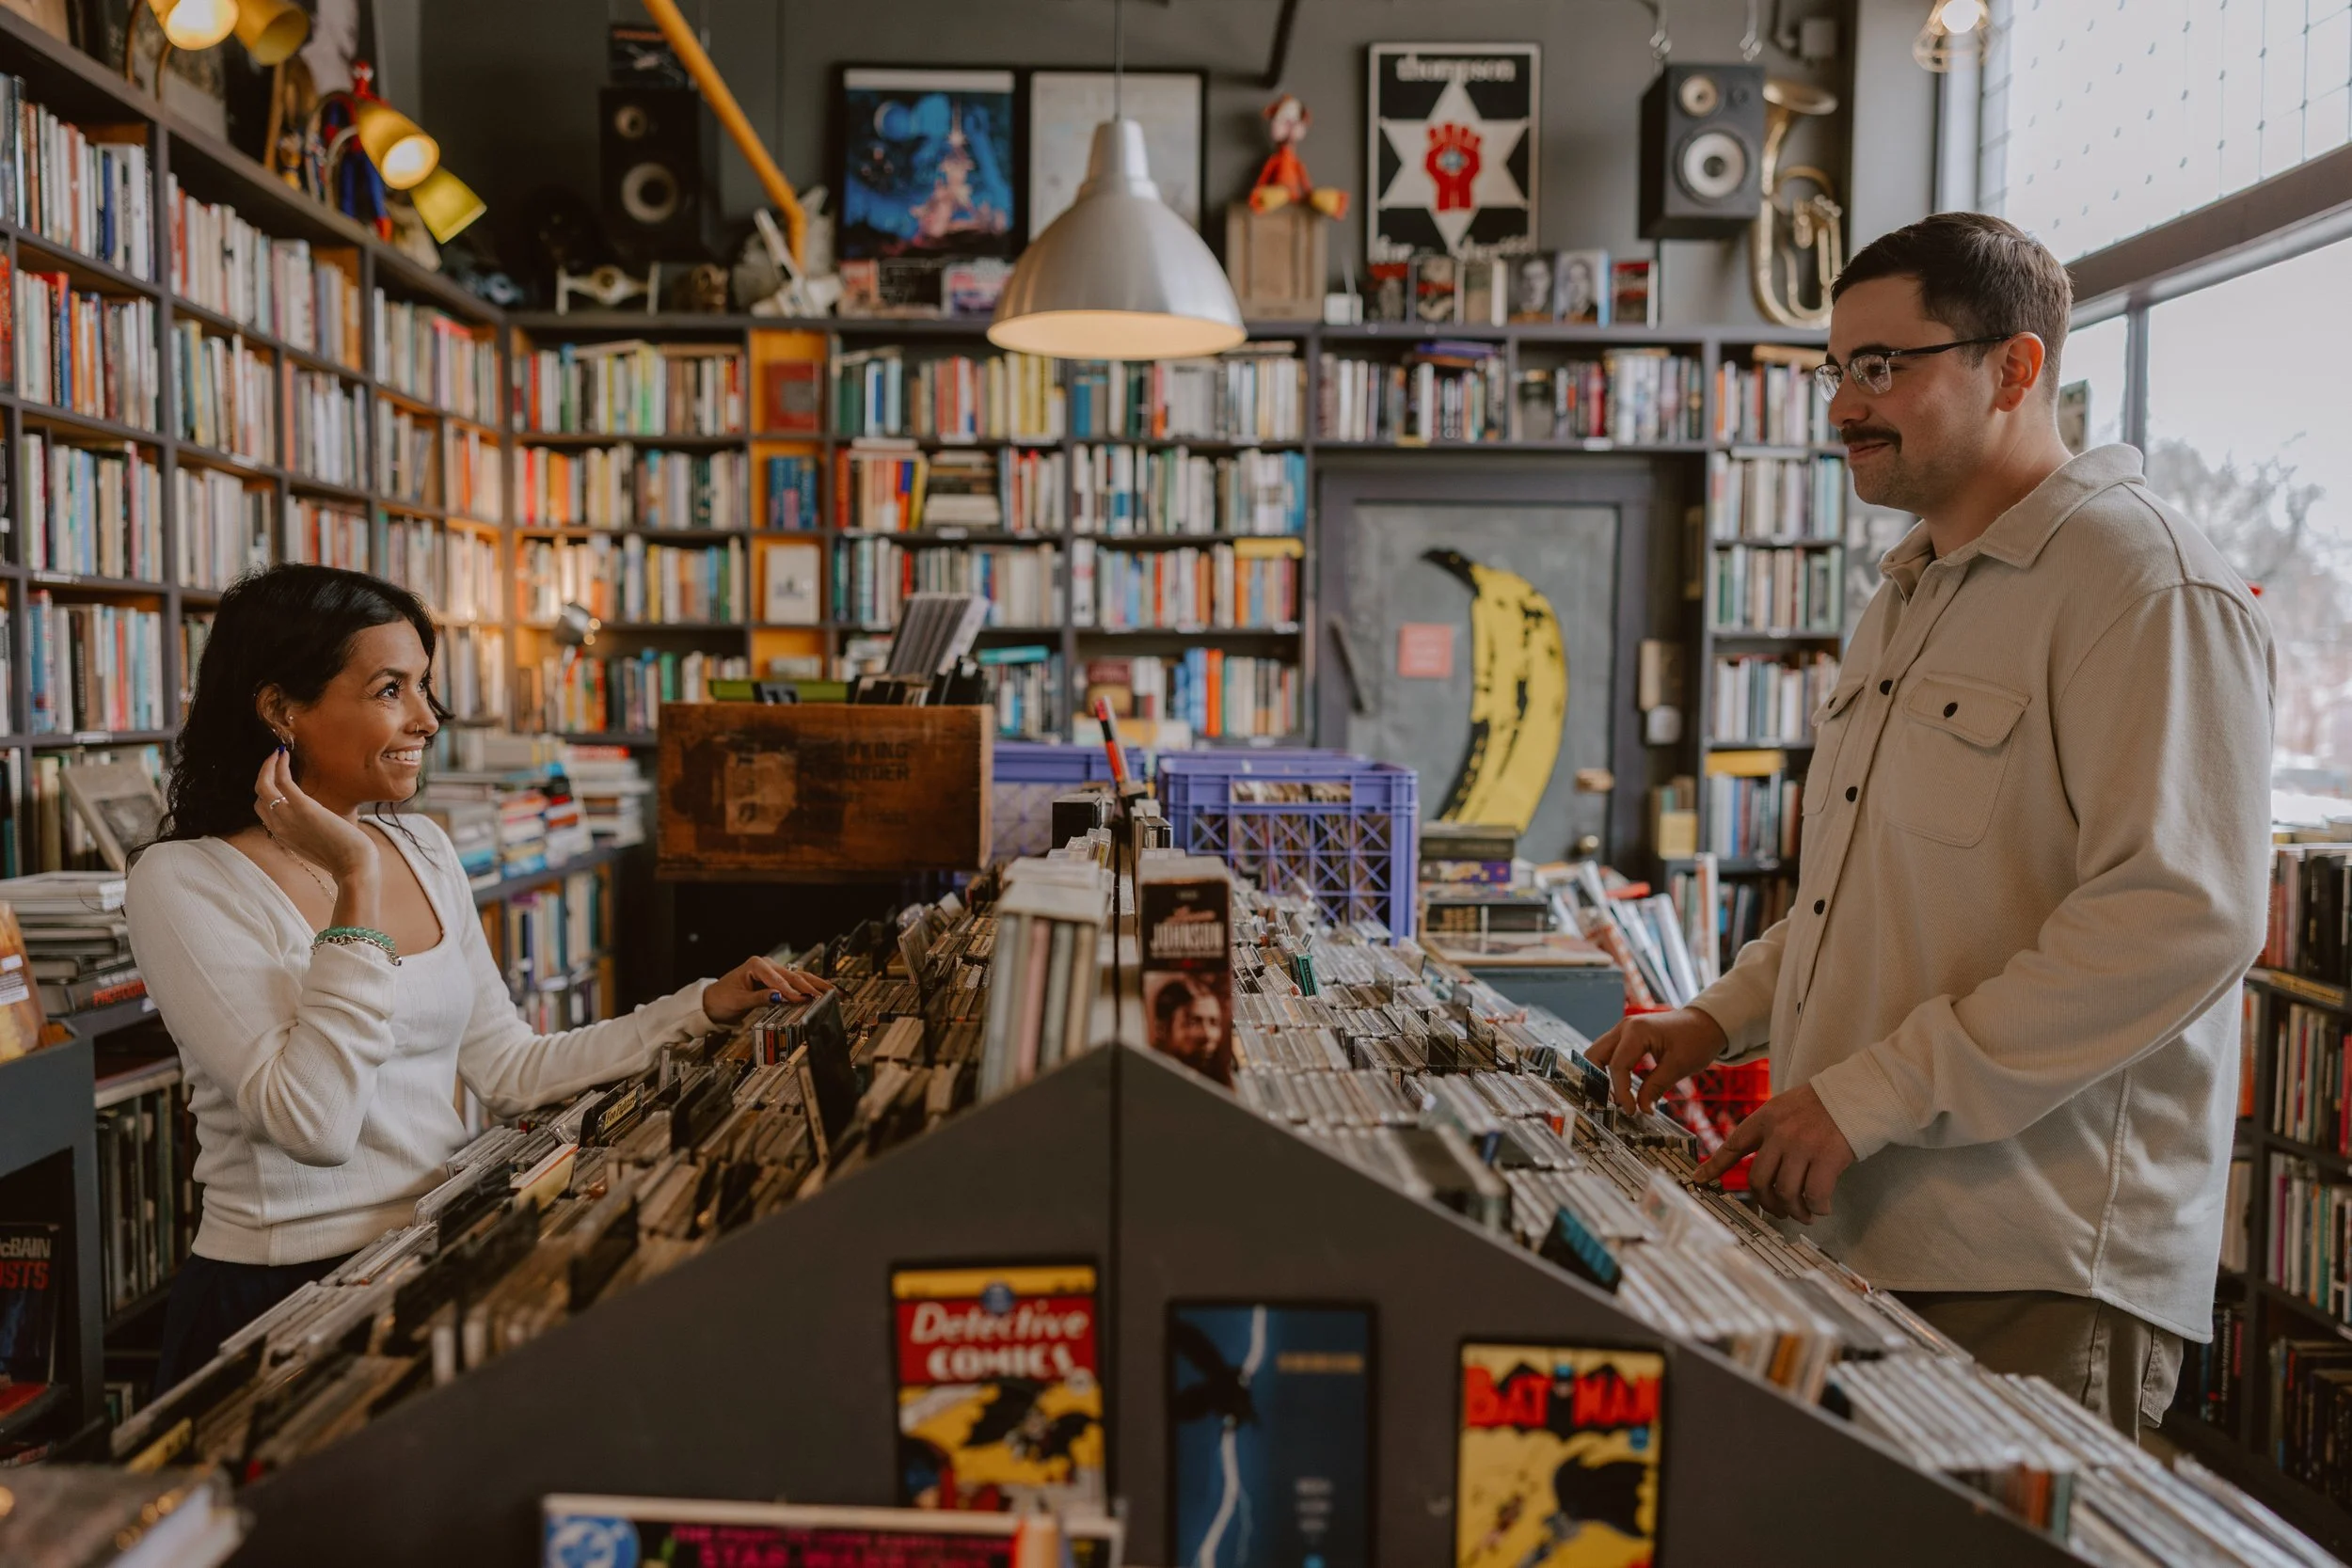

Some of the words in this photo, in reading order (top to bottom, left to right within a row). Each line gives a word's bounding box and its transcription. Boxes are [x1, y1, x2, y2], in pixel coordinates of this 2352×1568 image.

[1150, 923, 1224, 951] JOHNSON
[0, 1237, 51, 1259] cBAIN
[910, 1300, 1089, 1344] Detective
[927, 1342, 1075, 1381] COMICS
